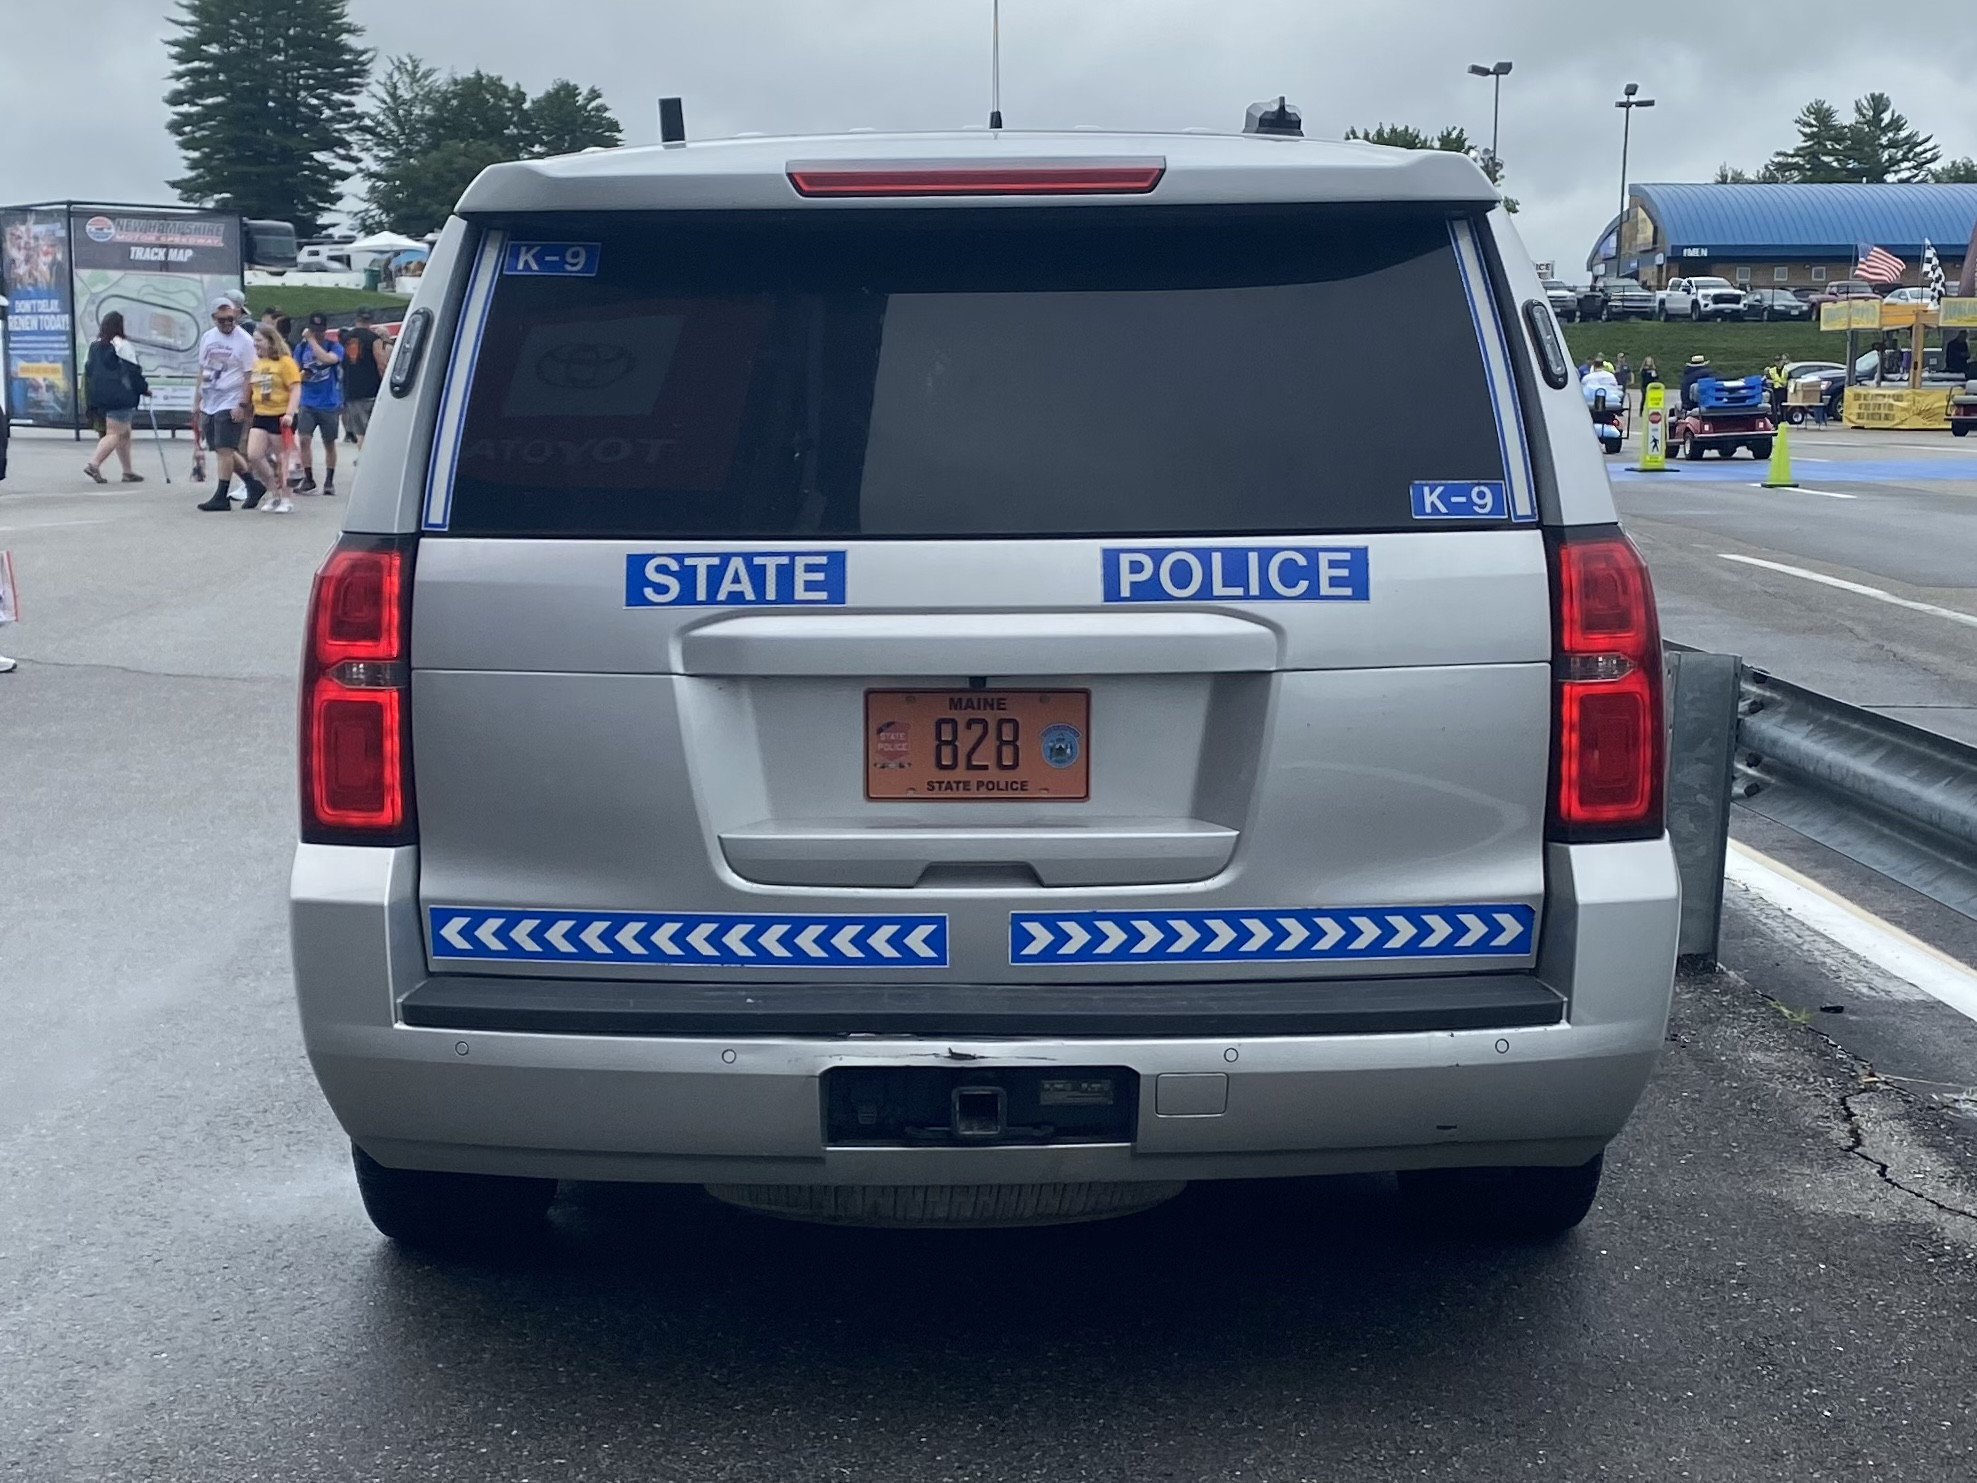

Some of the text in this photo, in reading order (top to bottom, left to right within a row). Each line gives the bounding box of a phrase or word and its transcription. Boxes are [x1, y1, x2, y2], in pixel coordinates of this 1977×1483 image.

[115, 218, 225, 236] NEW HAMPSHIRE
[115, 234, 221, 246] MOTOR SPEEDWAY
[129, 246, 194, 262] TRACK MAP
[517, 246, 587, 271] K-9
[8, 314, 38, 331] RENEW
[1423, 485, 1494, 514] K-9
[643, 550, 1353, 603] STATE POLICE
[948, 697, 1008, 711] MAINE
[880, 732, 906, 741] STATE
[935, 717, 1020, 771] 828
[877, 743, 909, 752] POLICE
[926, 780, 1029, 792] STATE POLICE
